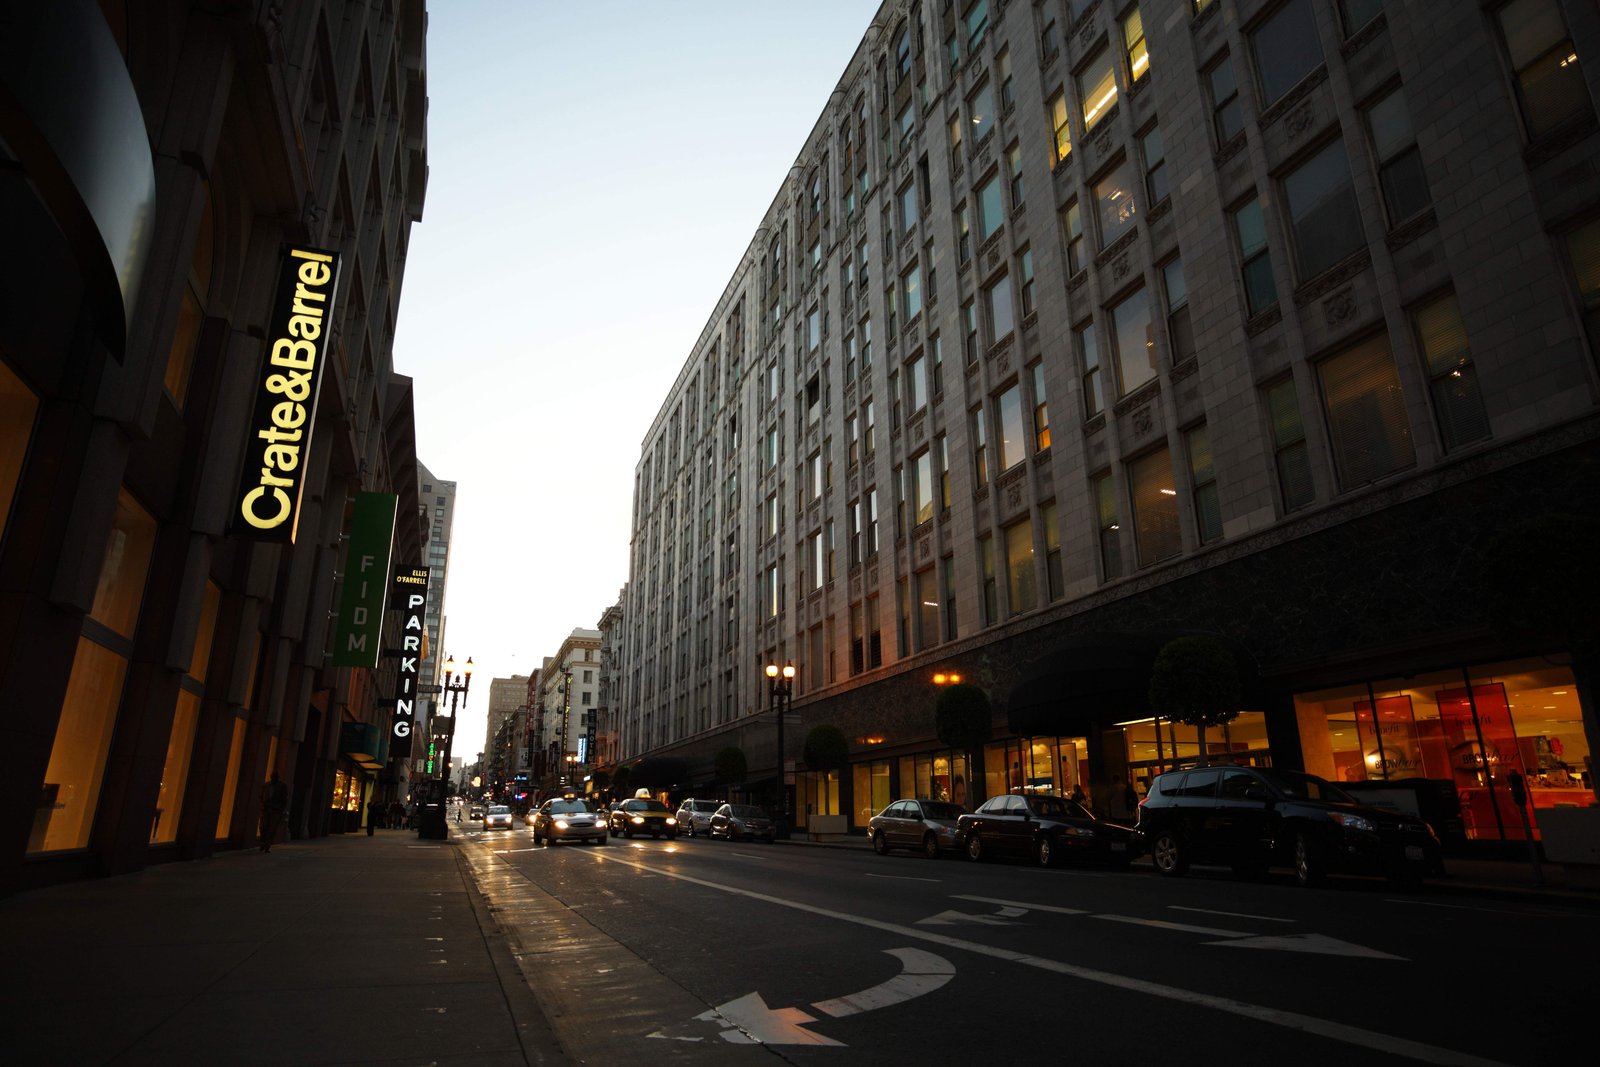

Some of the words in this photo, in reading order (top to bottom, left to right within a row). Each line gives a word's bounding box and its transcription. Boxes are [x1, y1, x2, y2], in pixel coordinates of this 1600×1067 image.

[241, 249, 333, 529] Crate&Barrel
[396, 575, 426, 585] O'FARRELL
[412, 569, 428, 577] ELLIS
[348, 555, 375, 653] FIDM
[393, 594, 425, 738] PARKING
[1454, 712, 1492, 728] benfit
[1368, 724, 1400, 735] bnefit
